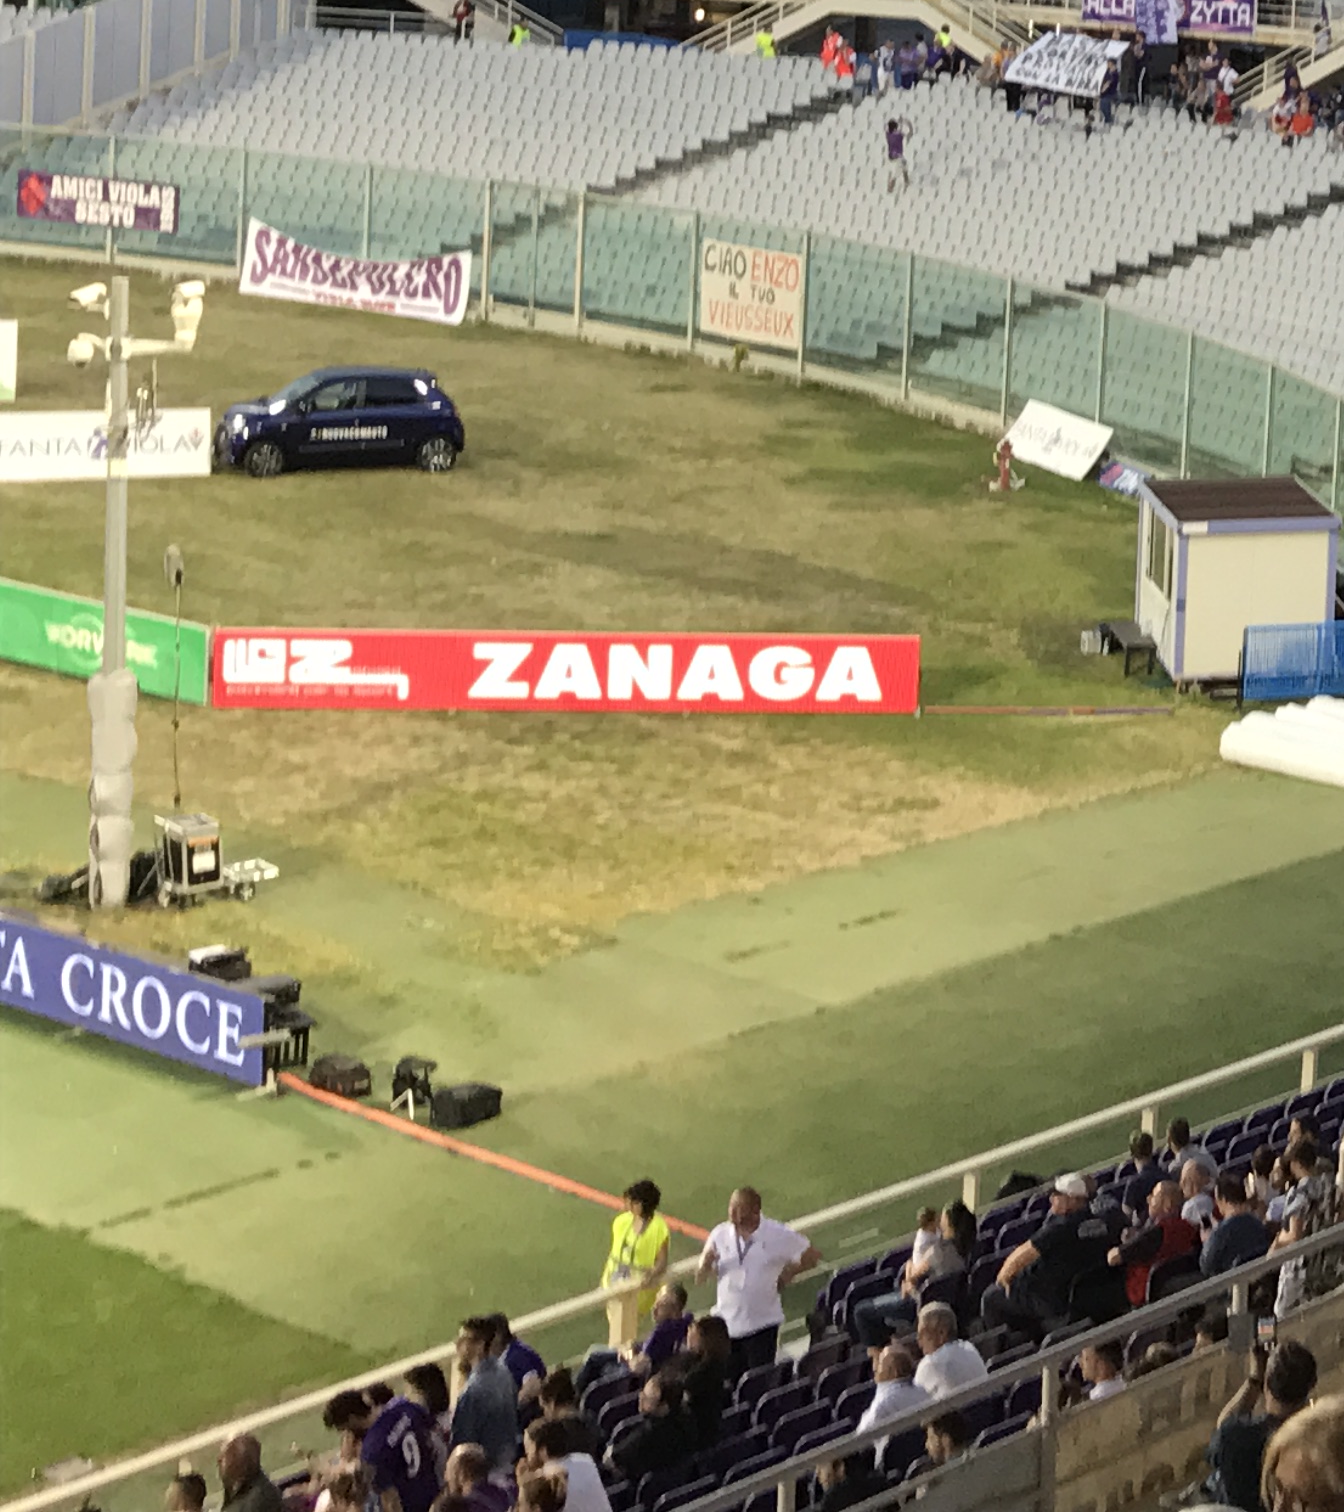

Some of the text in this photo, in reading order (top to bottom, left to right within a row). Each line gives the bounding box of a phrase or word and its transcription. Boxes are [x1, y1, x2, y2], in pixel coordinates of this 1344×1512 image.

[50, 173, 161, 209] AMICI VIOLA
[74, 198, 136, 229] SESTO
[704, 243, 800, 292] CIAO ENZO
[729, 281, 775, 305] IL TUO
[709, 297, 794, 339] VIEUSSEUX
[468, 642, 883, 702] ZANAGA
[60, 952, 245, 1069] CROCE
[401, 1430, 421, 1479] 9
